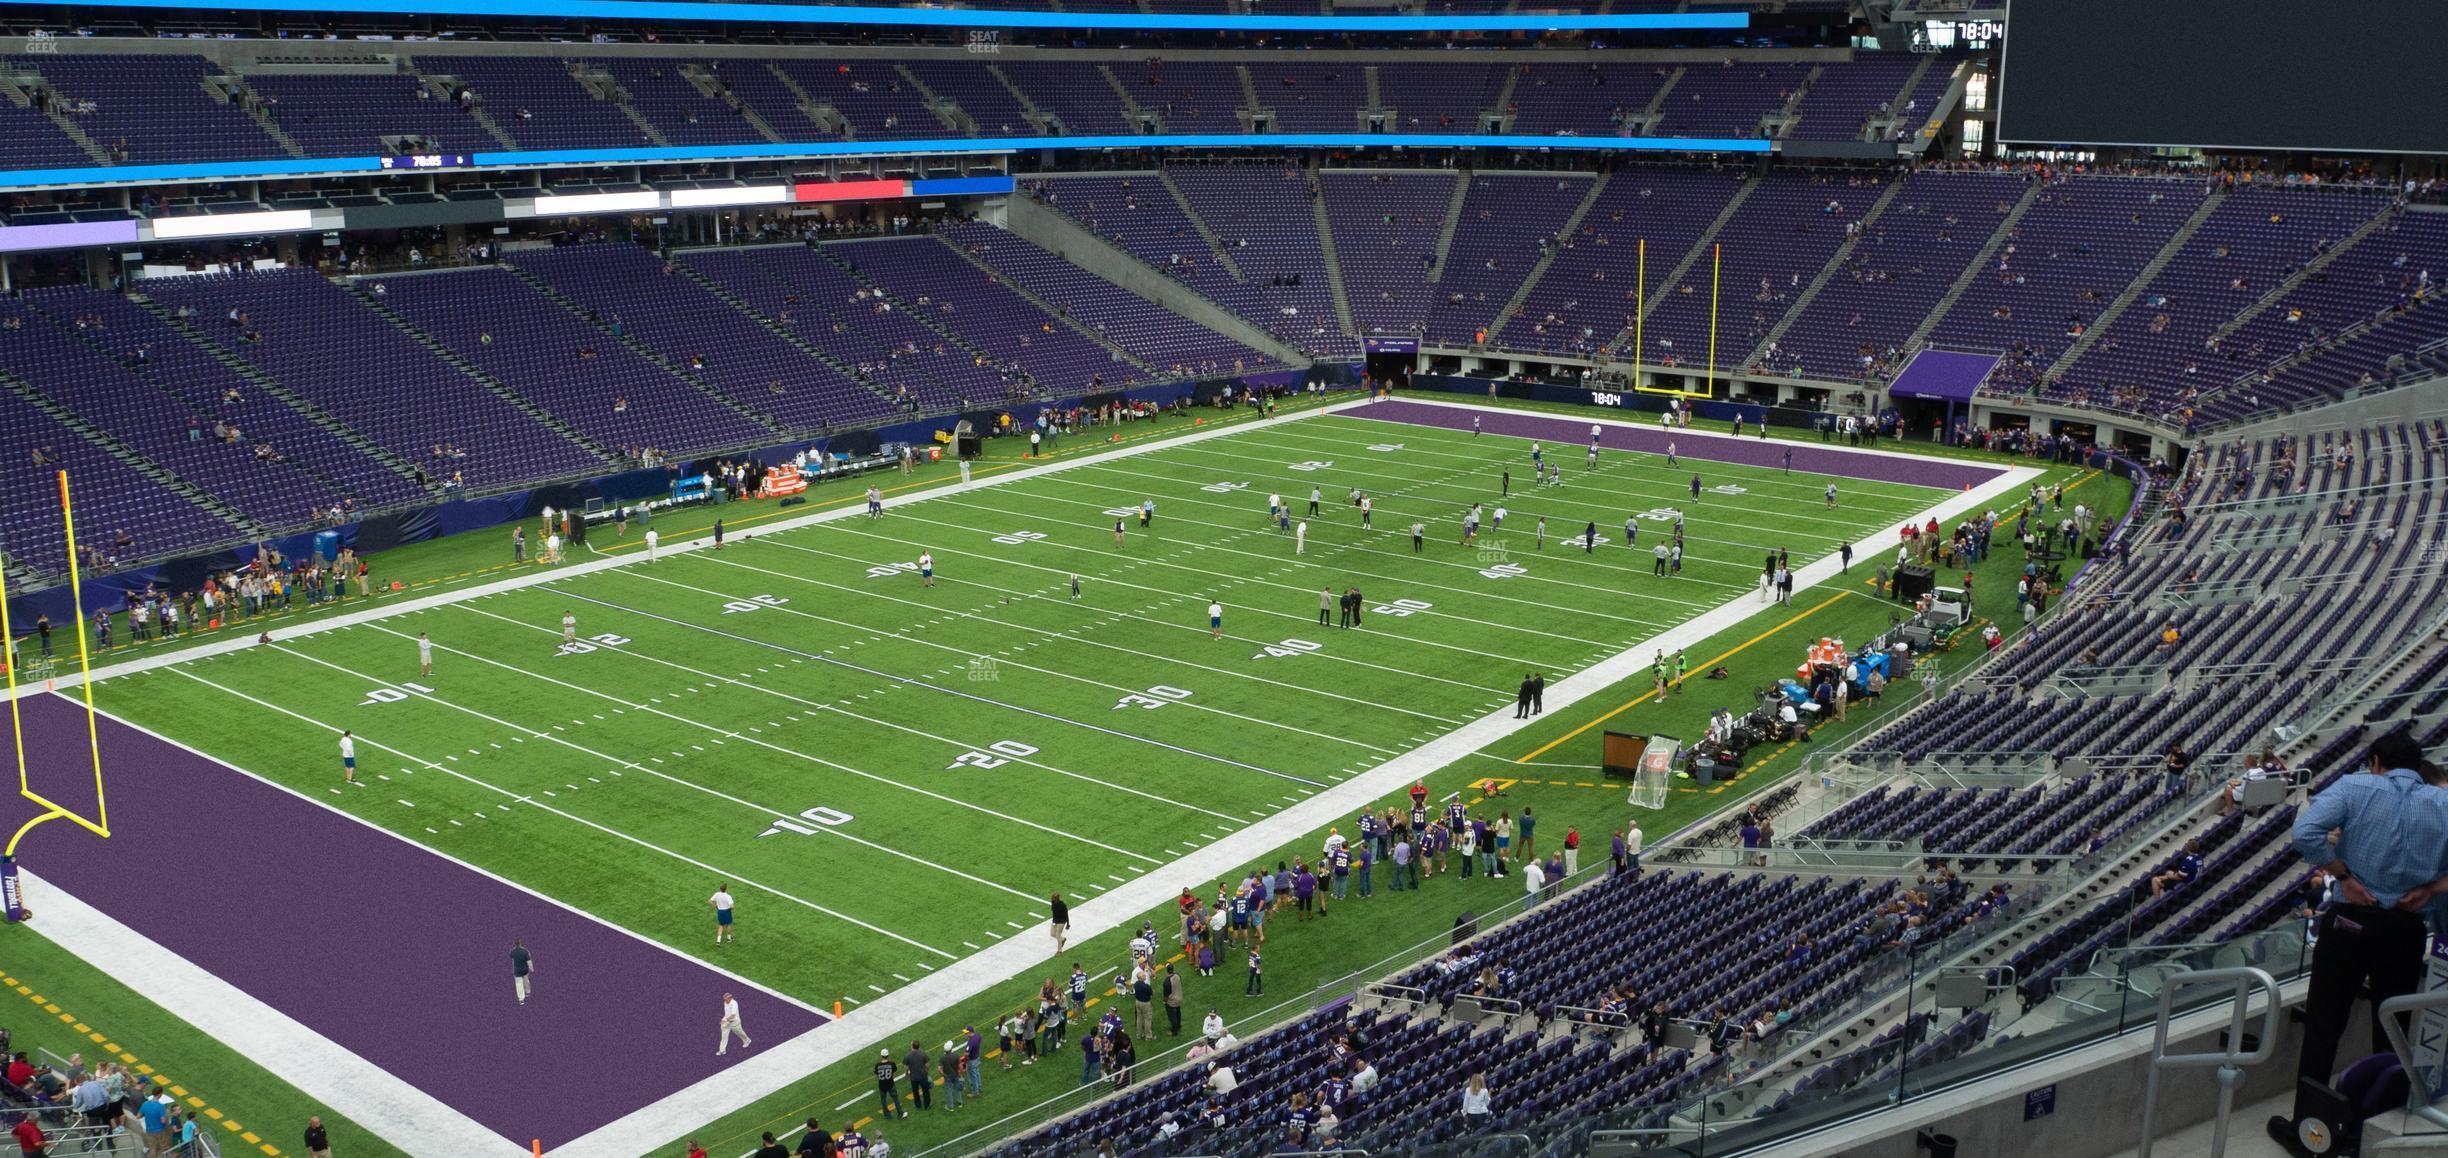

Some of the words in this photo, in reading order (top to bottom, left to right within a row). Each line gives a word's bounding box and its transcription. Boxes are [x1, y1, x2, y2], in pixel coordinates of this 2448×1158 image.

[1958, 22, 2003, 39] 78:04
[1591, 392, 1621, 405] 78:04
[1371, 598, 1433, 617] 50
[1263, 638, 1324, 657] 40
[1118, 685, 1194, 710] 30
[955, 740, 1040, 769] 20
[772, 806, 855, 836] 10
[1413, 812, 1424, 823] 81
[1360, 818, 1371, 831] 22
[1336, 856, 1347, 867] 28
[1236, 903, 1246, 914] 12
[1103, 1022, 1114, 1035] 17
[878, 1068, 892, 1080] 28
